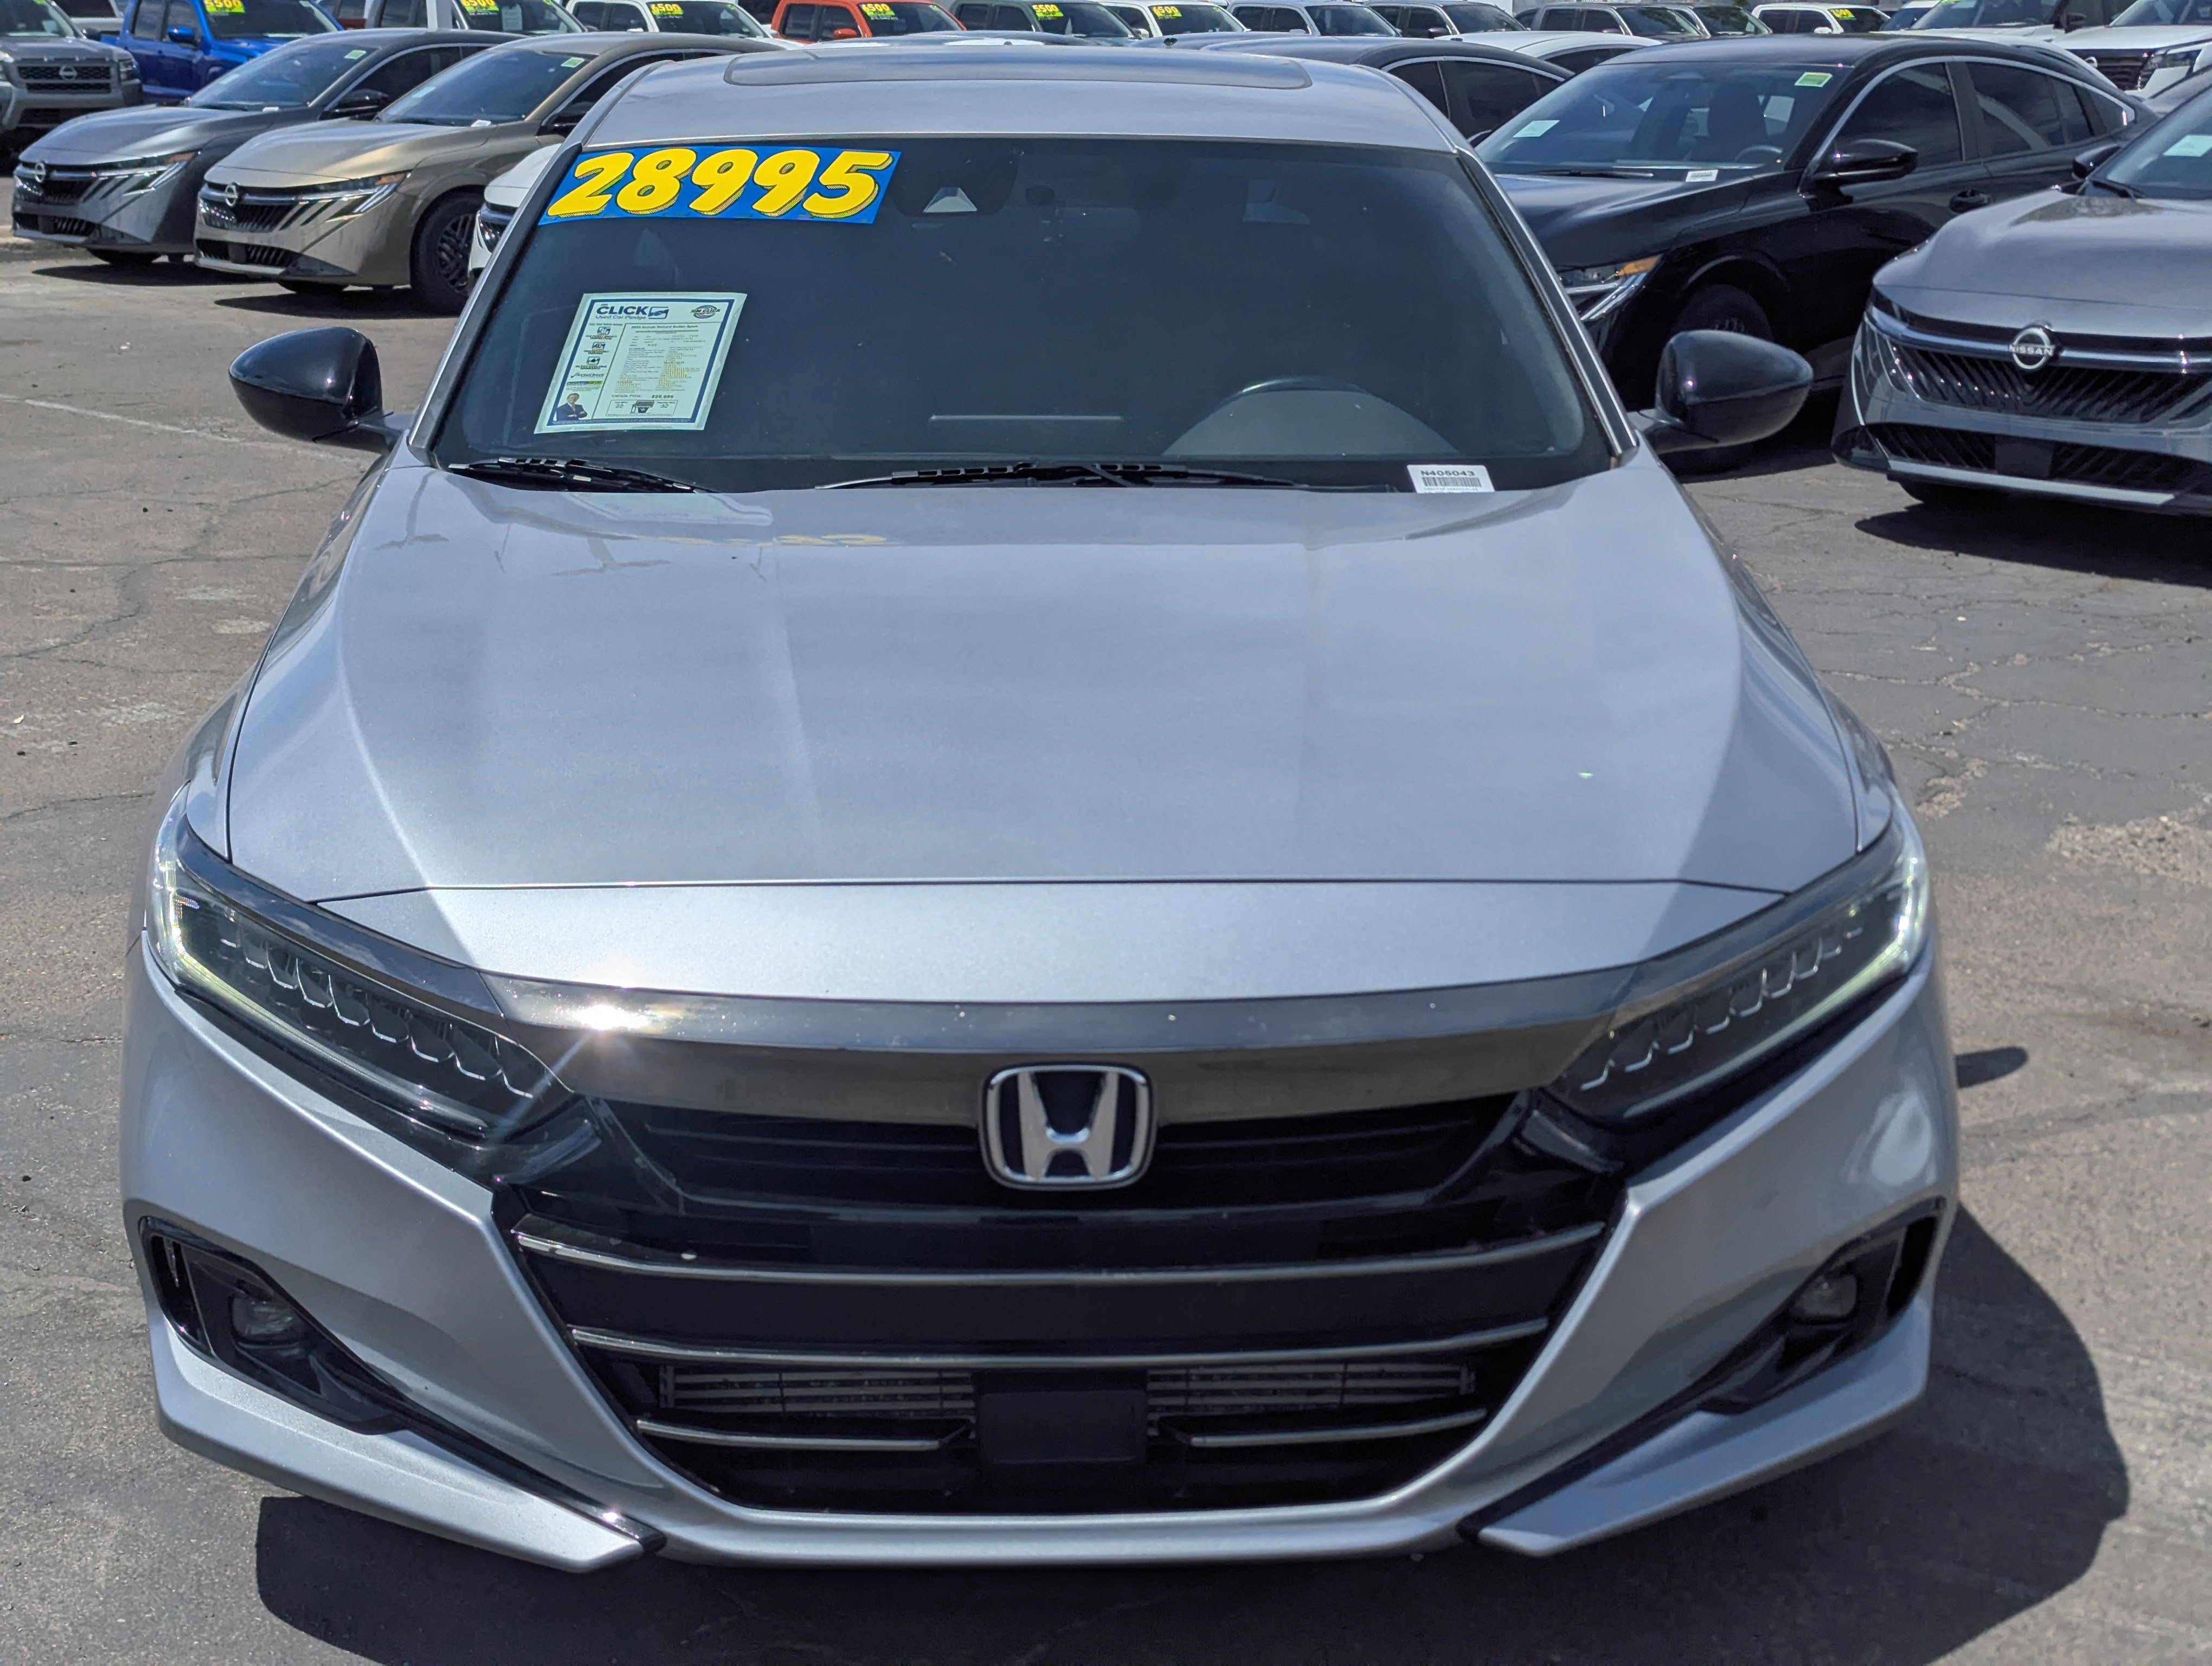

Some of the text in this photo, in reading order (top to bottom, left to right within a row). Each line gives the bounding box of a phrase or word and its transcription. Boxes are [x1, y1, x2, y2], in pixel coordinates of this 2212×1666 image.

[651, 3, 682, 12] 6500
[861, 3, 891, 12] 6500
[1032, 4, 1059, 12] 5500
[546, 148, 893, 219] 28995
[596, 306, 649, 315] CLICK
[2009, 344, 2055, 356] NISSAN
